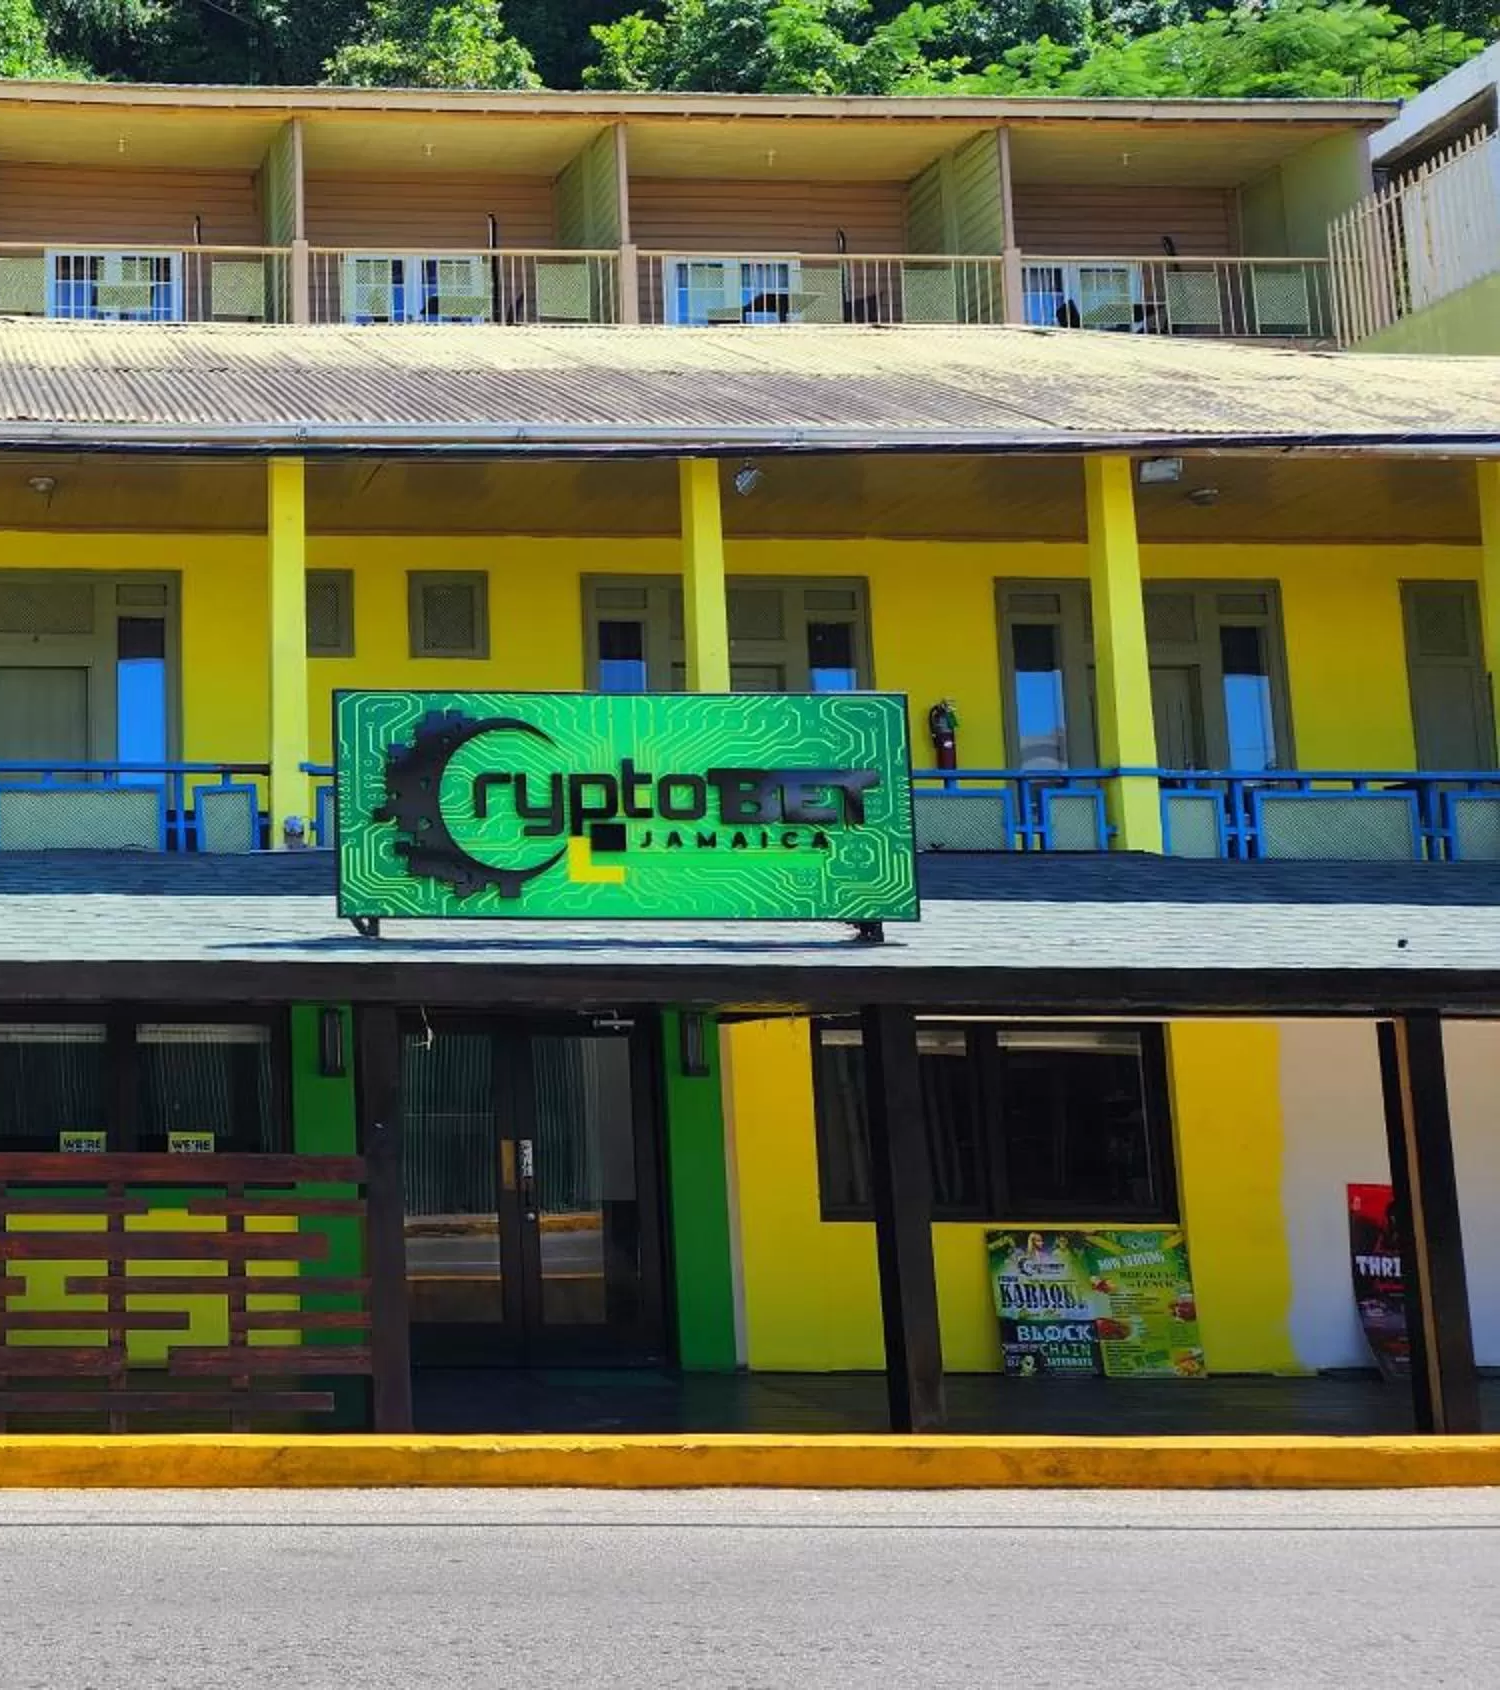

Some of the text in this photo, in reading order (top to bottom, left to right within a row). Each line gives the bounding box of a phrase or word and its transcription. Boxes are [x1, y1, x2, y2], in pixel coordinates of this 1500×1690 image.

[374, 710, 880, 898] CryptoBET
[639, 830, 833, 850] JAMAICA
[1016, 1325, 1092, 1342] BLOCK
[1039, 1343, 1092, 1357] CHAIN
